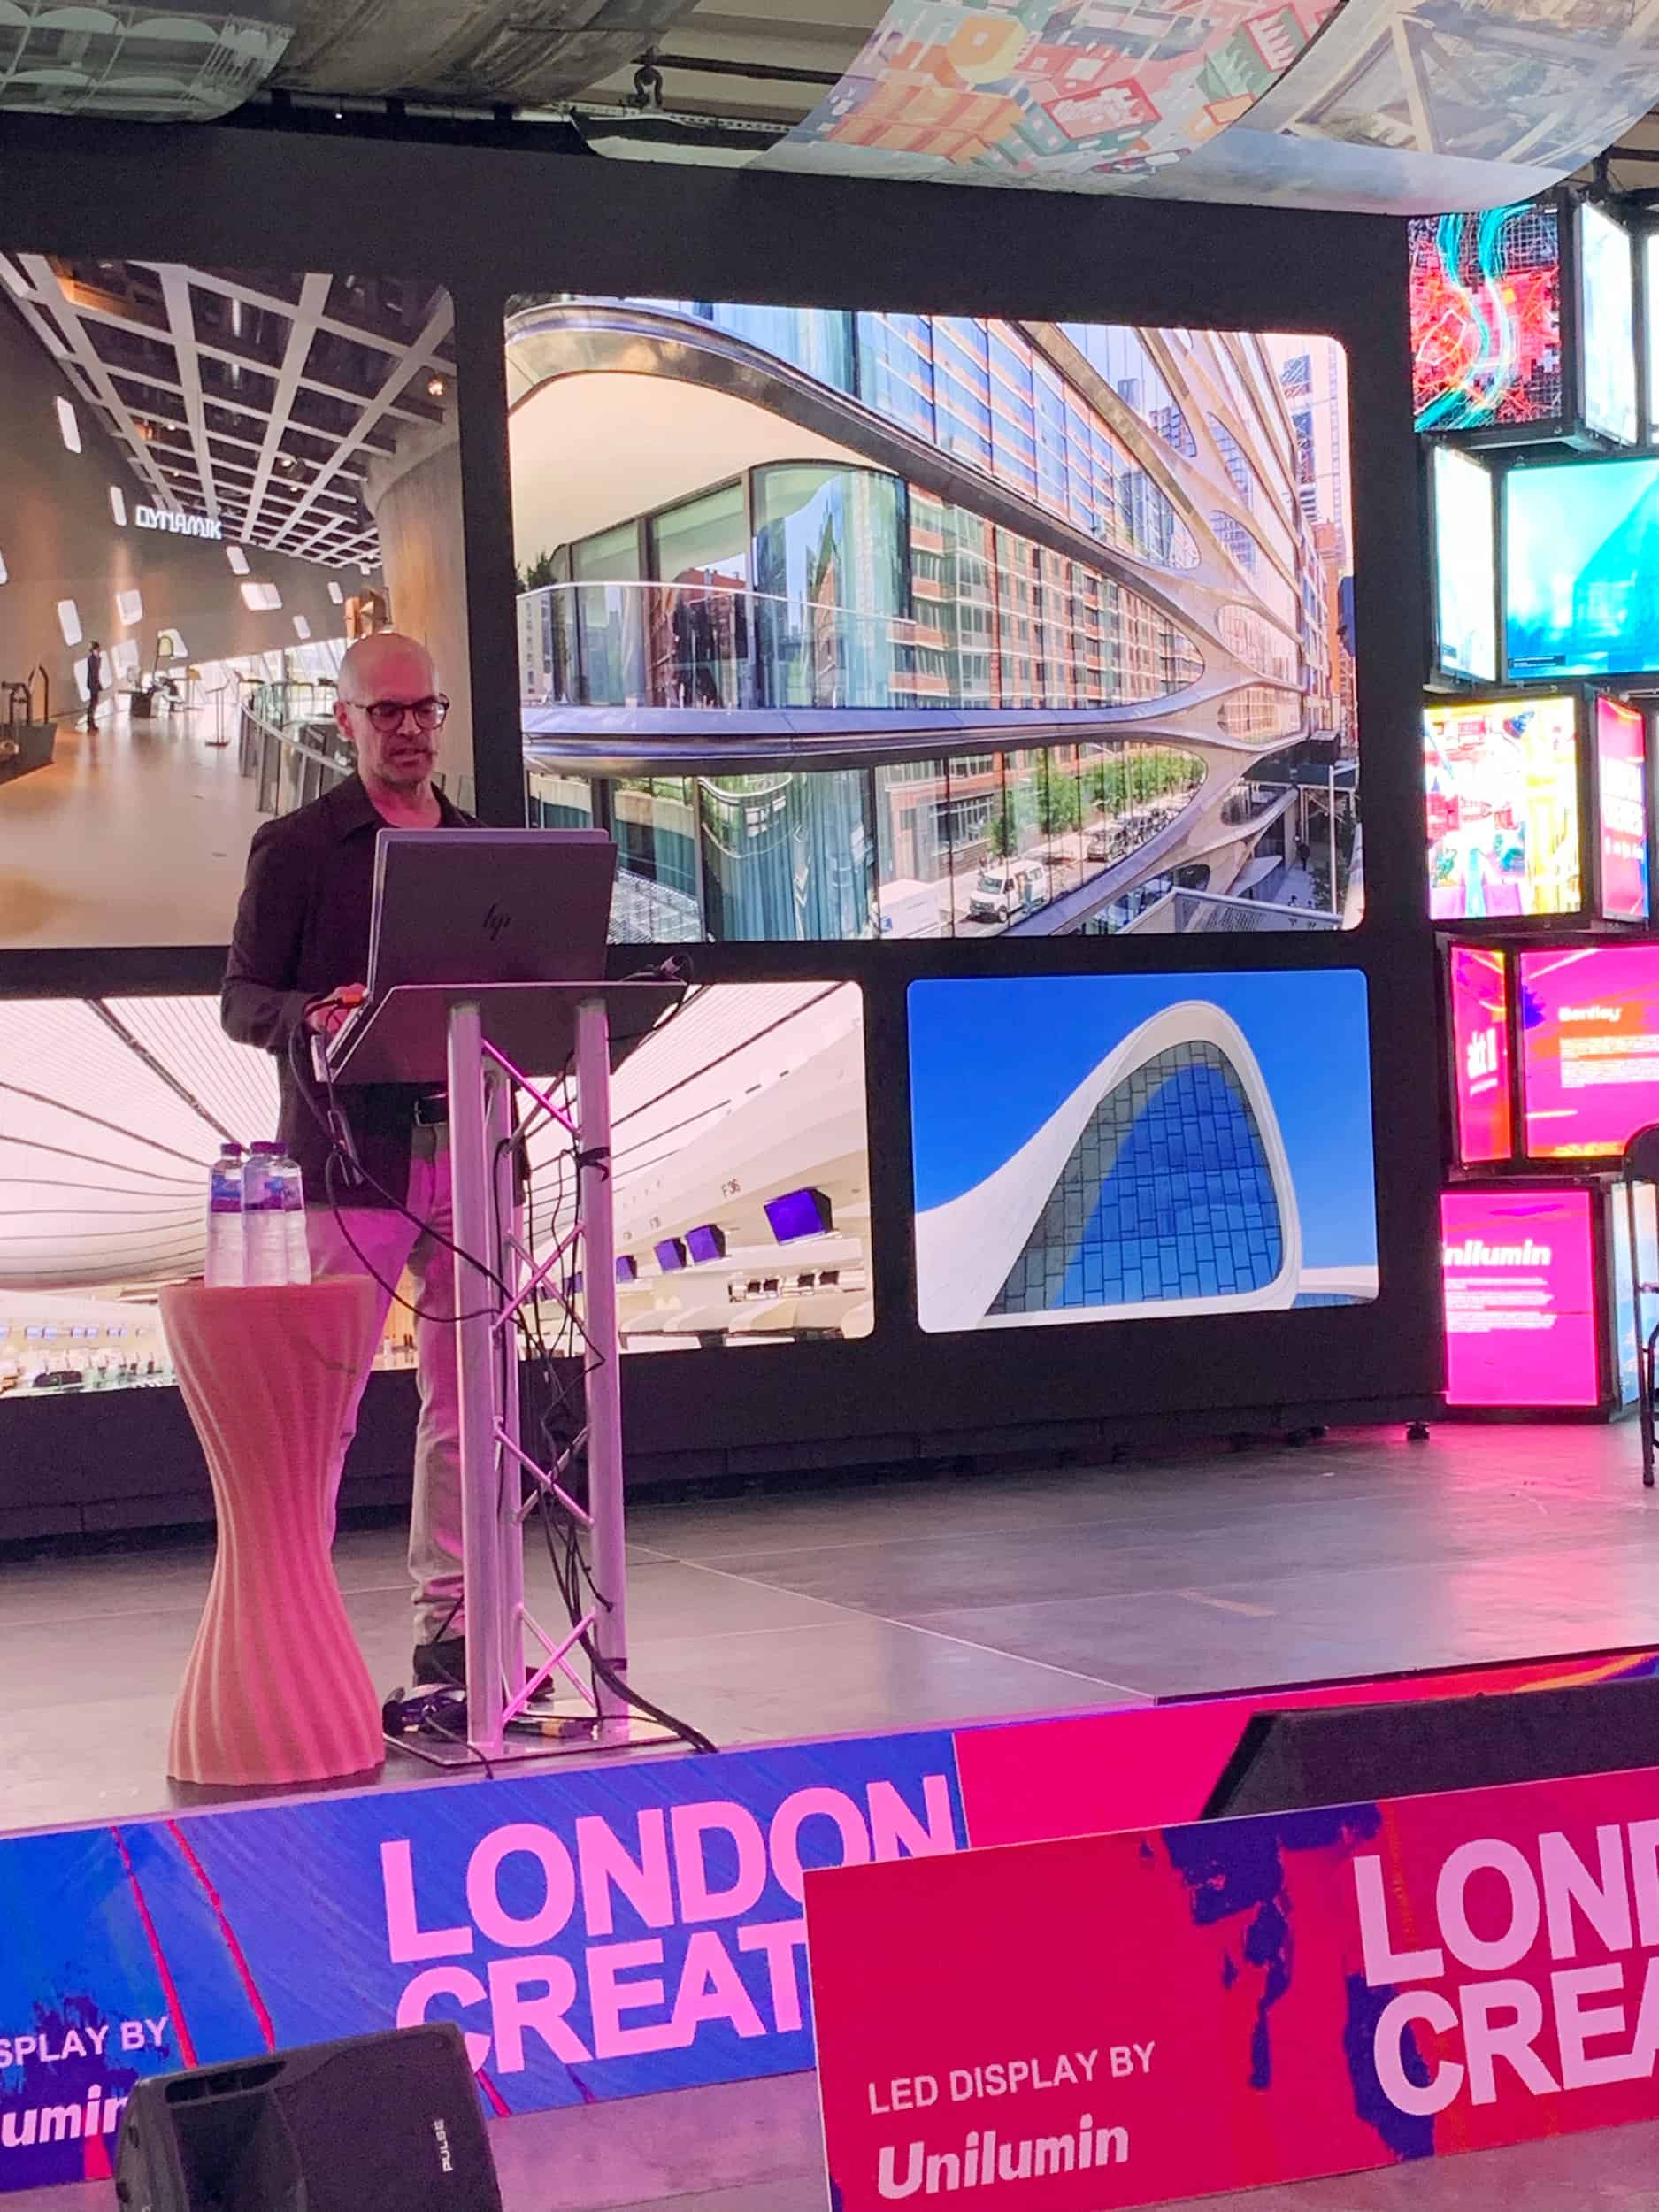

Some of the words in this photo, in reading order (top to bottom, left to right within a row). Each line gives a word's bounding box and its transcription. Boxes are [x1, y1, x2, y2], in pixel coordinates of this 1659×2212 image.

[380, 1774, 956, 1963] LONDON
[1353, 1819, 1659, 1987] LON
[120, 2016, 169, 2052] BY
[867, 2075, 939, 2115] LED
[949, 2048, 1099, 2102] DISPLAY
[1109, 2039, 1156, 2078] BY
[1373, 1956, 1659, 2116] CRE
[434, 2118, 454, 2173] PULSE
[877, 2113, 1130, 2200] Unilumin
